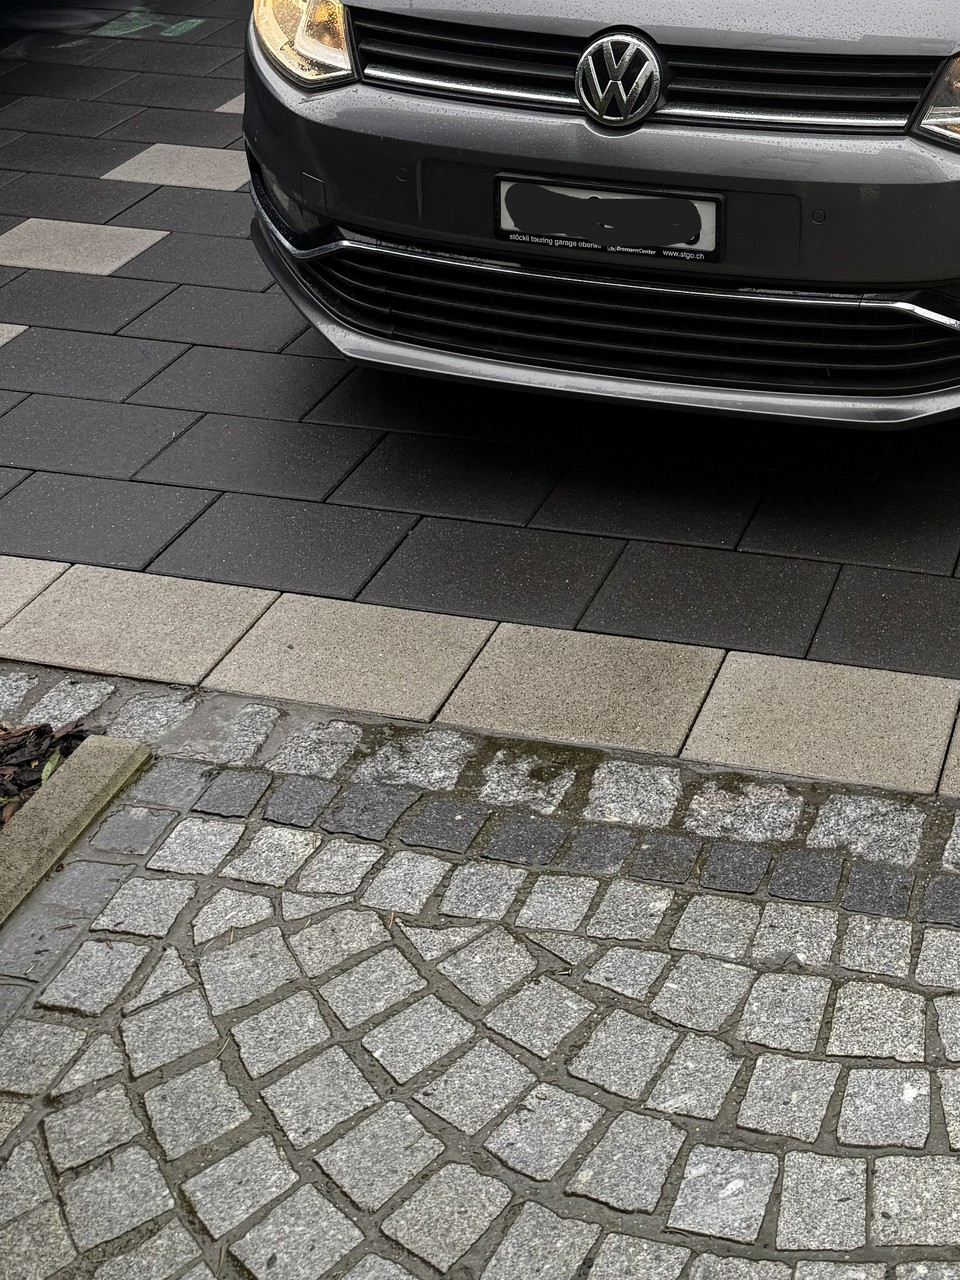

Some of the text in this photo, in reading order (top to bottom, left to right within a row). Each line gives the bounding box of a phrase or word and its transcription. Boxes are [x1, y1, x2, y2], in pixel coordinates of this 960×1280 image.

[530, 236, 553, 246] touring
[554, 238, 577, 248] garage
[662, 249, 705, 260] www.stgo.ch
